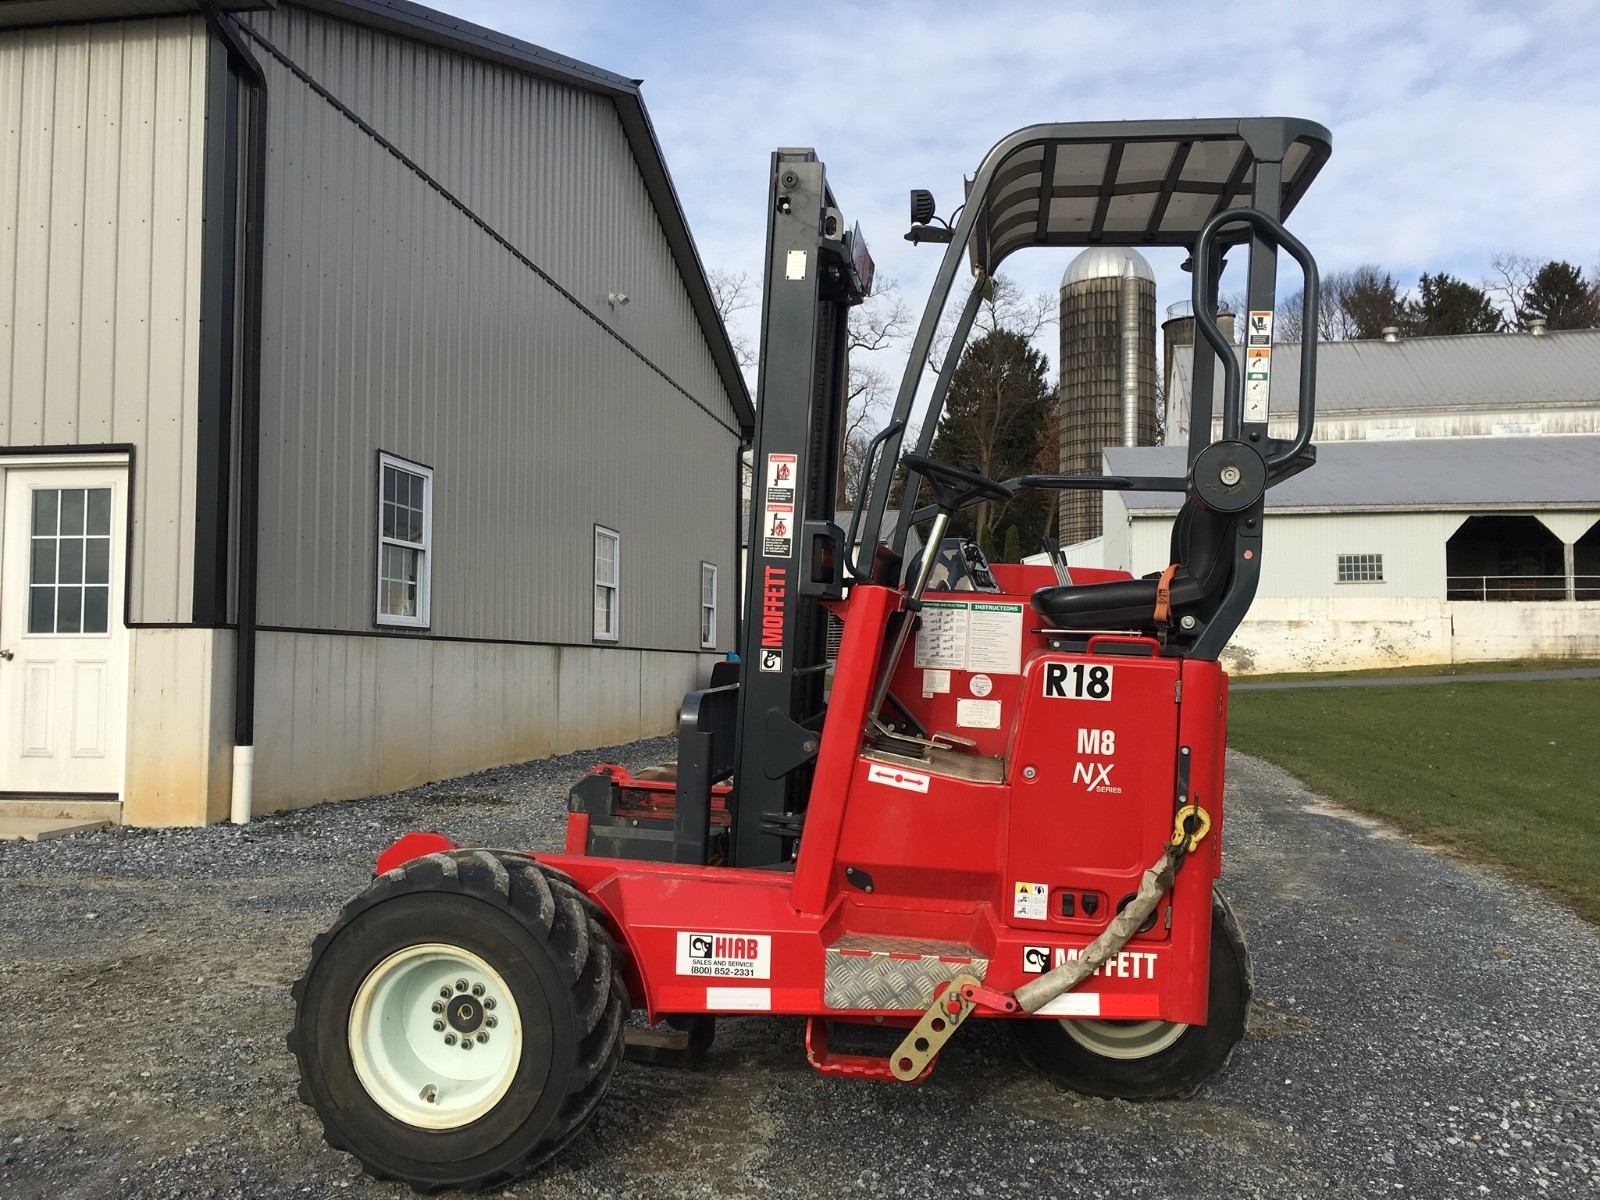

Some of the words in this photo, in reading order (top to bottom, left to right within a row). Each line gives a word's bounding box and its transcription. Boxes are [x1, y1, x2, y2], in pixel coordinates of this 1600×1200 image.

[762, 565, 786, 647] MOFFETT
[1045, 663, 1110, 699] R18
[1077, 728, 1115, 756] M8
[1072, 761, 1115, 792] NX
[1096, 786, 1122, 794] SERIES
[715, 937, 758, 960] HIAB
[691, 966, 712, 975] (800)
[714, 968, 754, 976] 852-2331
[1055, 948, 1158, 979] MFETT
